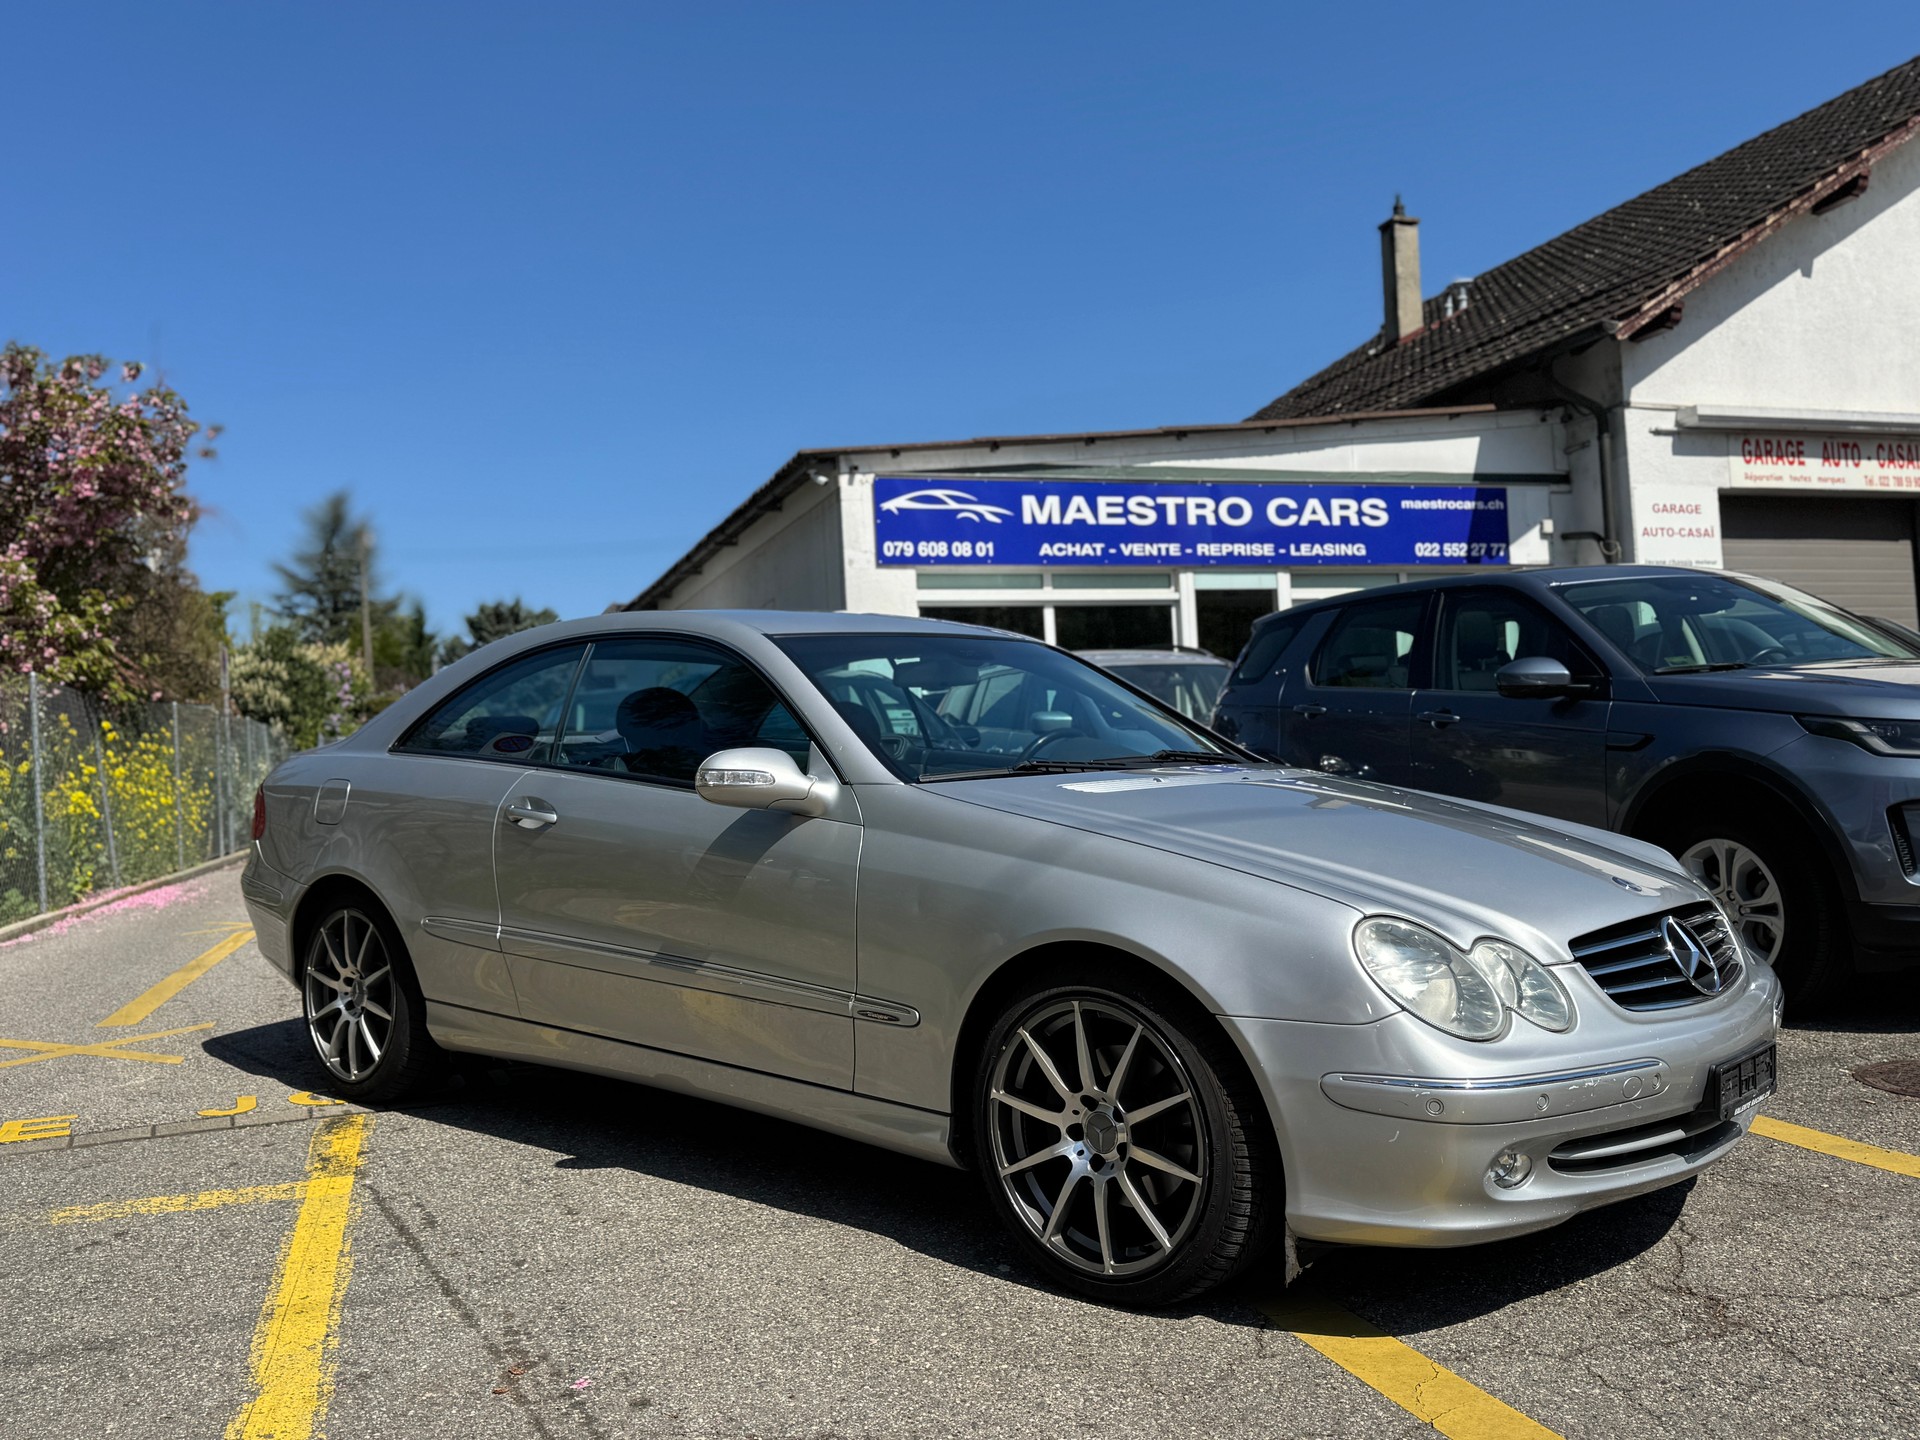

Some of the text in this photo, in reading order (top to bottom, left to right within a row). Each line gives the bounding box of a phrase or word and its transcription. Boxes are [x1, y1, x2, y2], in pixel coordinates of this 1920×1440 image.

[1741, 438, 1806, 467] GARAGE
[1821, 441, 1862, 469] AUTO
[1021, 494, 1390, 528] MAESTRO CARS
[1400, 498, 1505, 511] maestrocars.ch
[1652, 503, 1702, 515] GARAGE
[883, 541, 995, 558] 079 608 08 01
[1038, 542, 1106, 557] ACHAT
[1119, 542, 1182, 557] VENTE
[1196, 542, 1276, 557] REPRISE
[1289, 542, 1367, 558] LEASING
[1414, 542, 1507, 558] 022 552 27 77
